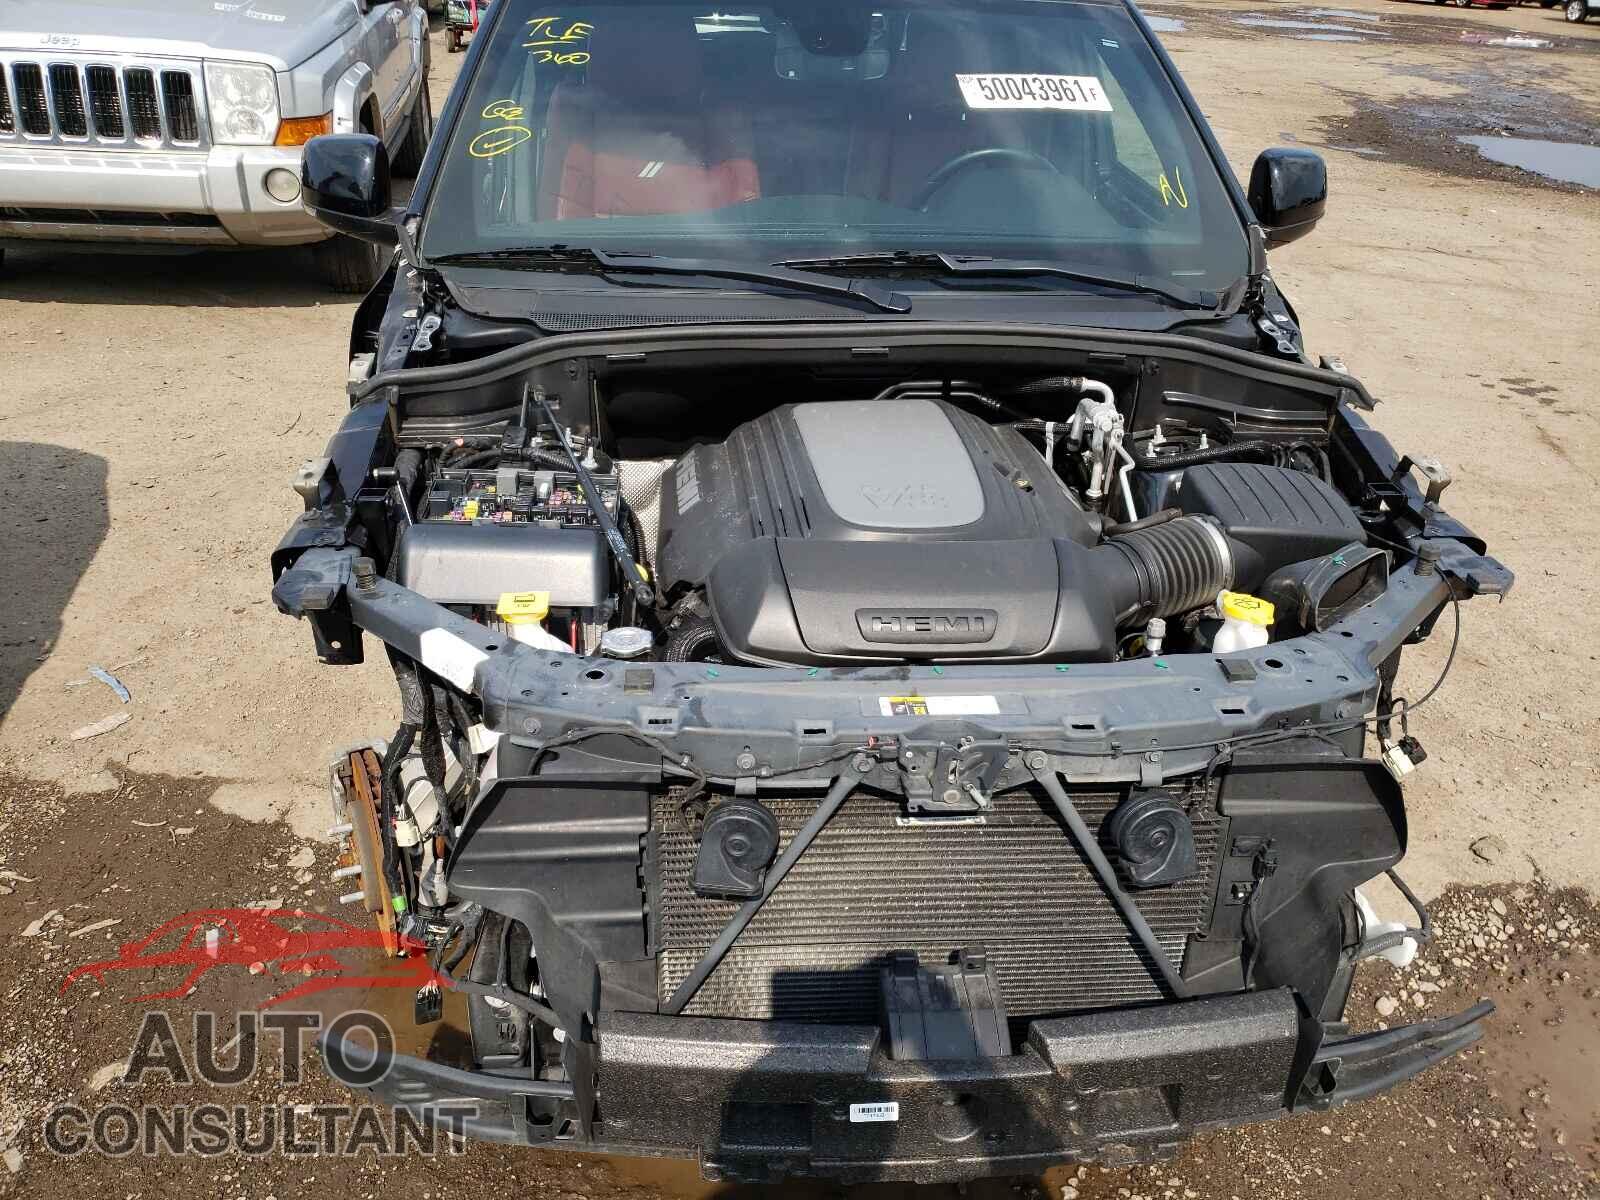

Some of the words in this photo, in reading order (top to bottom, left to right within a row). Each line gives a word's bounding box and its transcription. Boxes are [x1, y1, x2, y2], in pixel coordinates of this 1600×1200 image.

[39, 33, 81, 48] Jeep
[976, 77, 1090, 102] 50043961
[871, 616, 985, 632] HEMI
